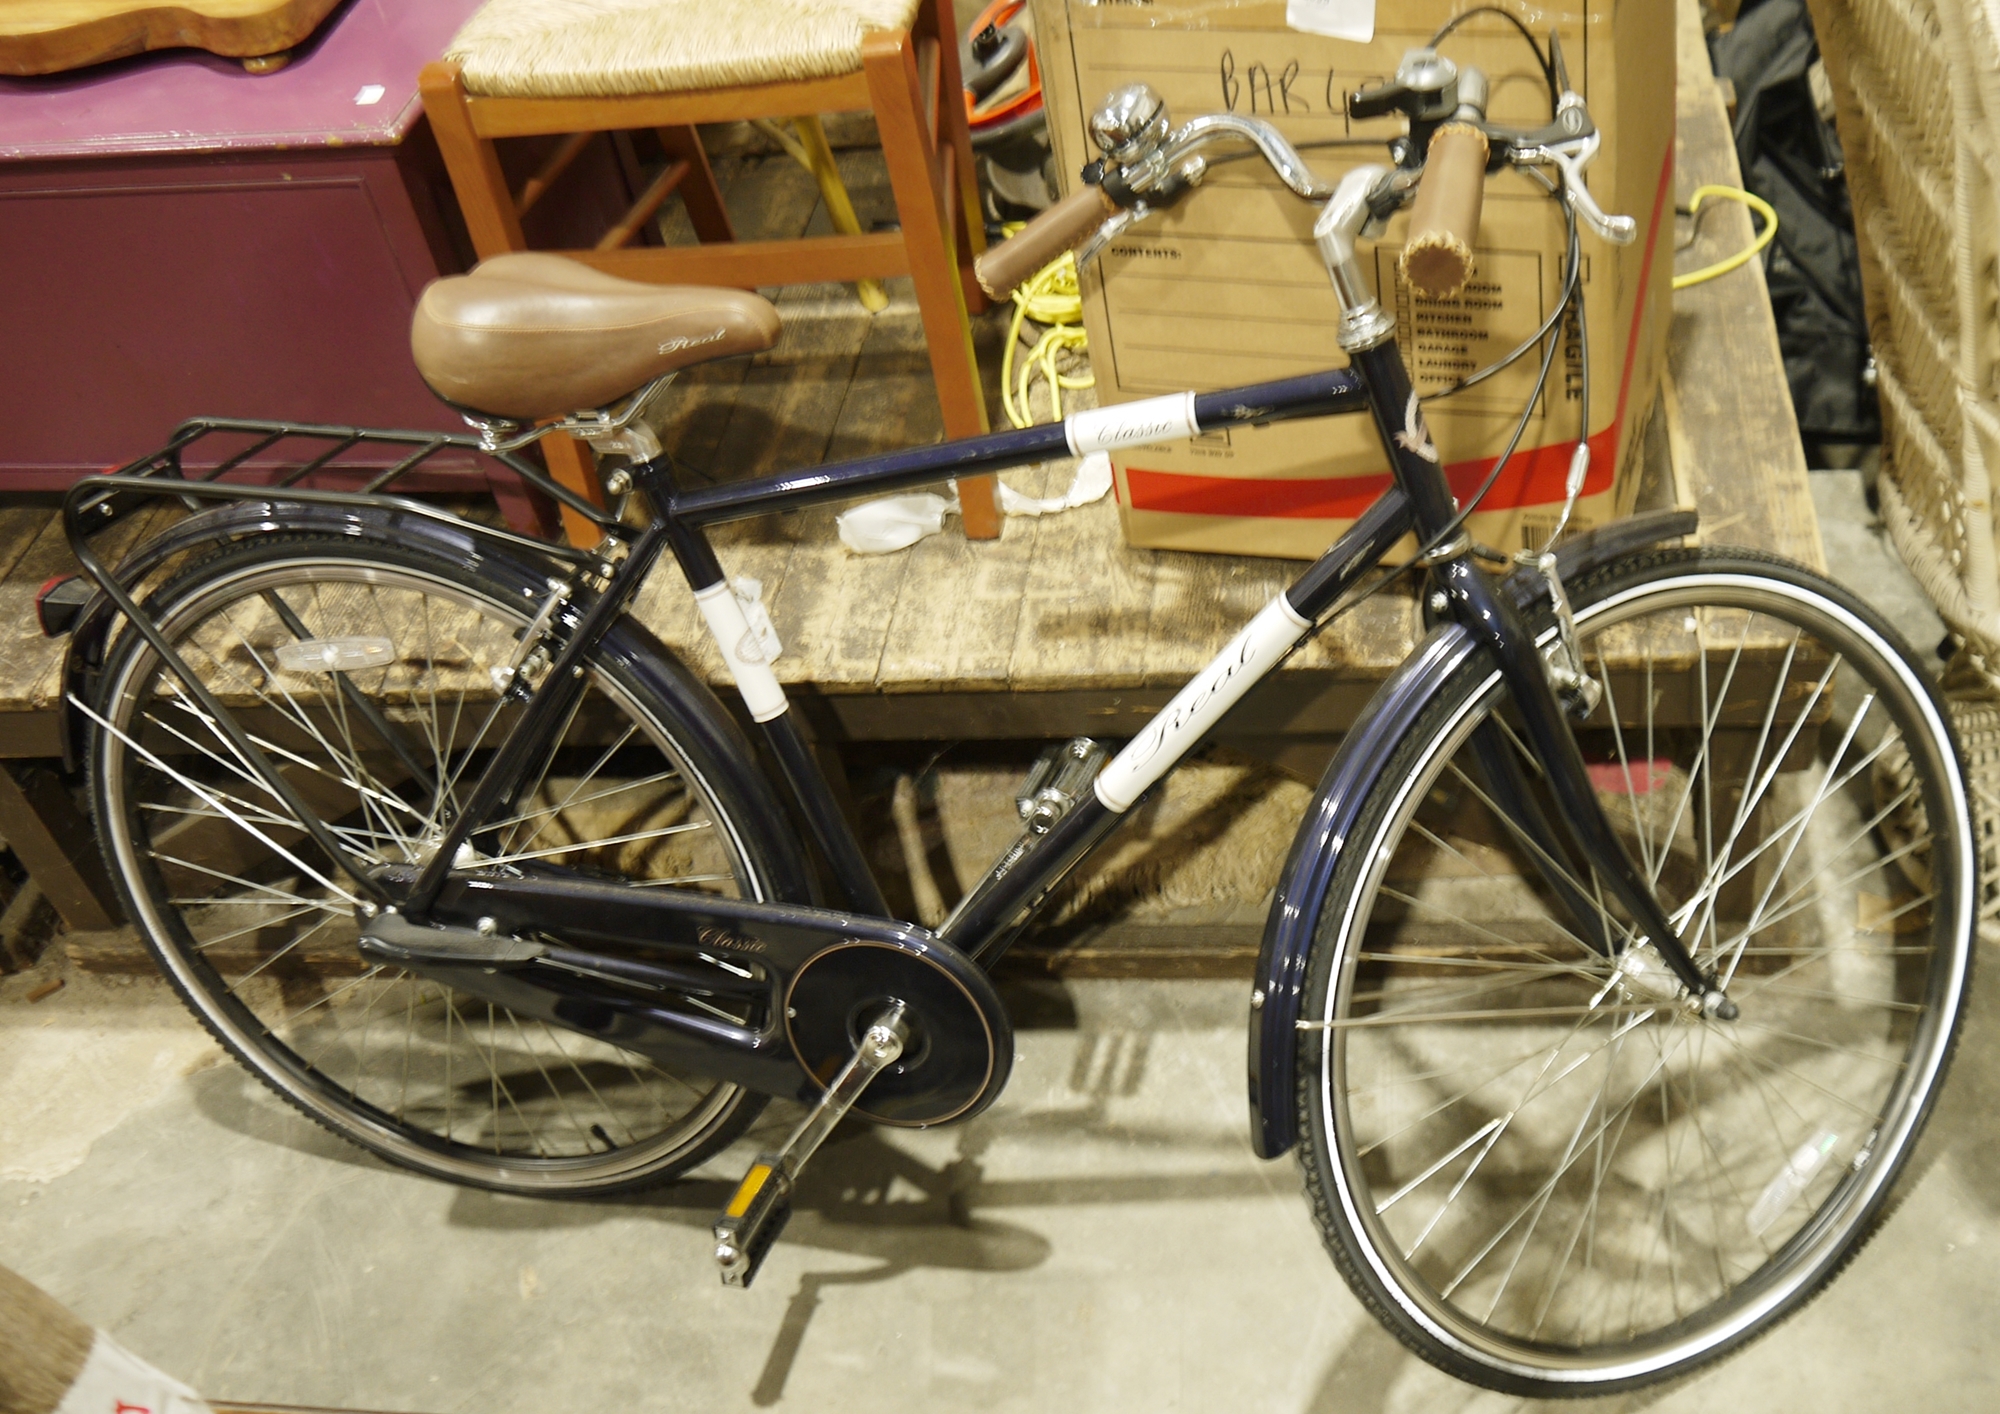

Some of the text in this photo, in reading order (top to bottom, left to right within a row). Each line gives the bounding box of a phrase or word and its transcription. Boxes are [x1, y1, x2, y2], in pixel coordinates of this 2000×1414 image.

[1220, 49, 1310, 114] BAR
[1111, 245, 1181, 259] CONTENTS:
[1415, 297, 1503, 312] DINING ROOM
[1416, 313, 1472, 325] KITCHEN
[1416, 329, 1489, 342] BATHROOM
[1418, 344, 1468, 356] GARAGE
[1418, 359, 1477, 371] LAUNDRY
[1420, 373, 1464, 386] OFFICE
[1095, 419, 1173, 445] Classic
[1131, 634, 1257, 773] Real
[697, 926, 768, 954] Classic
